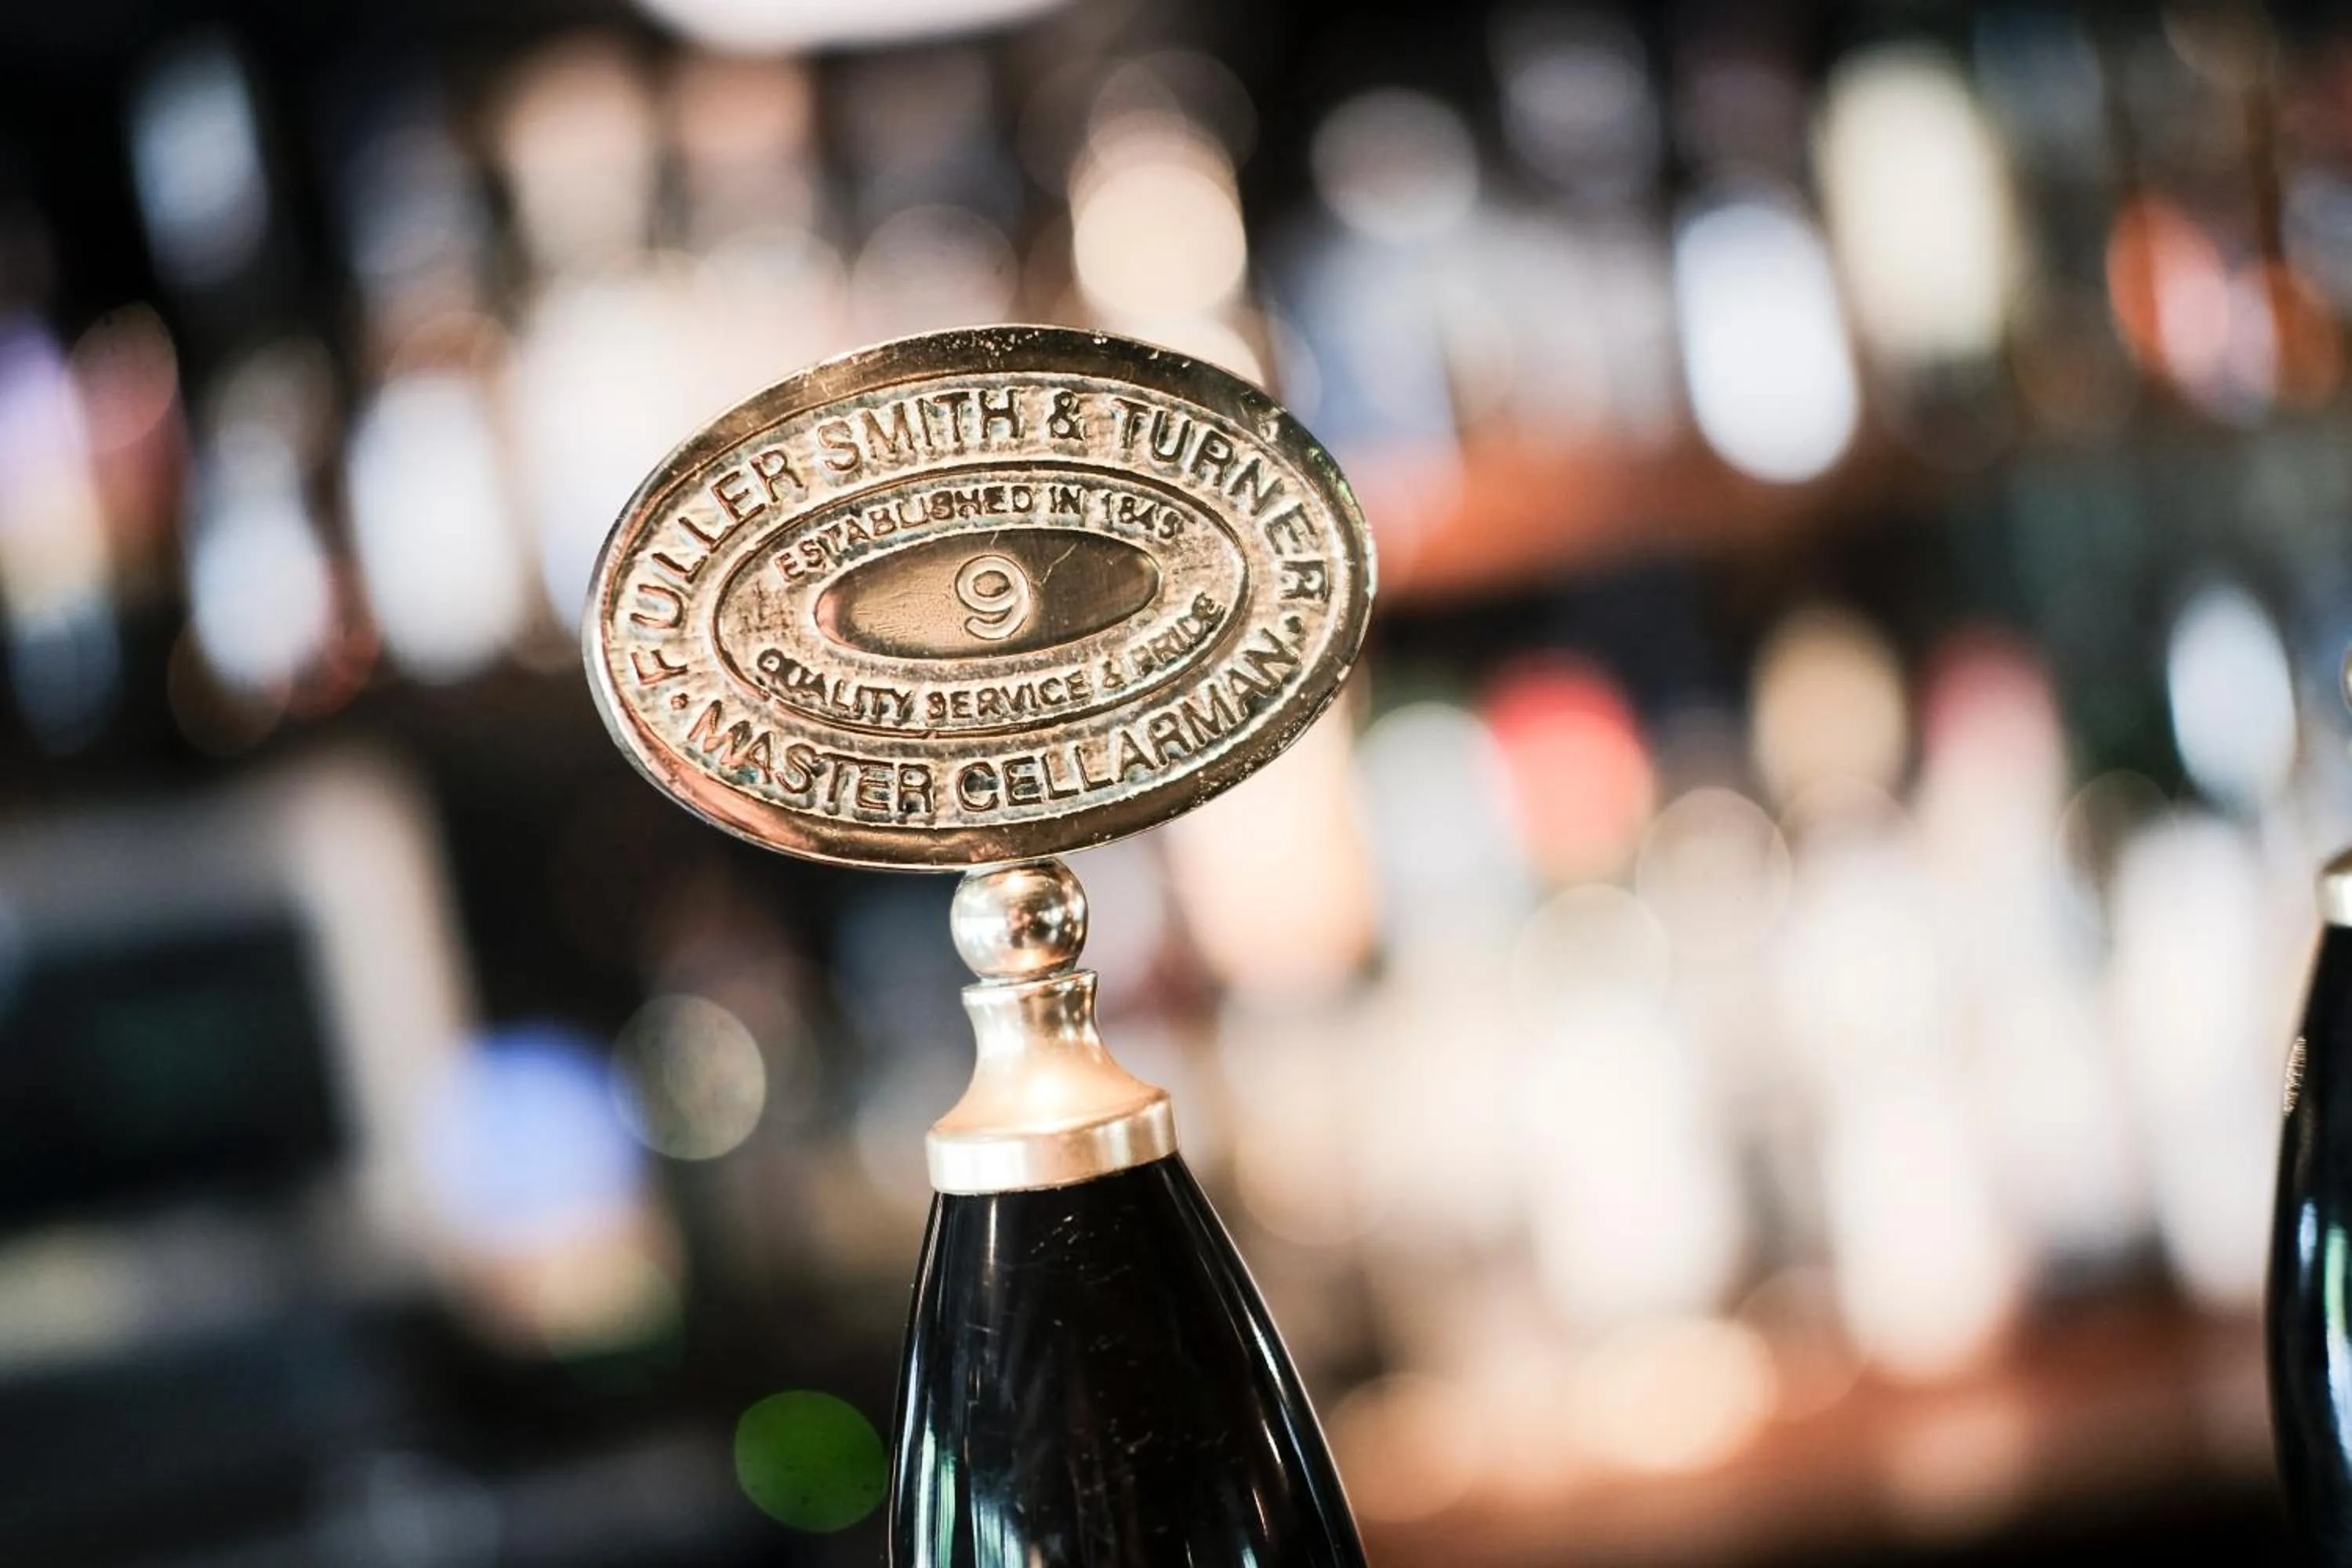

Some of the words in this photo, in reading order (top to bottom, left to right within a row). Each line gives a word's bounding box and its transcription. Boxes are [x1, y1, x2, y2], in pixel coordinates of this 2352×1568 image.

[630, 448, 804, 685] FULLER
[817, 390, 1021, 471] SMITH
[1047, 390, 1086, 441] &
[1113, 397, 1329, 601] TURNER
[774, 485, 1033, 583] ESTABLISHED
[1049, 485, 1083, 514] IN
[954, 554, 1029, 641] 9
[688, 700, 938, 813] MASTER
[956, 628, 1300, 813] CELLARMAN
[757, 648, 916, 725] QUALITY
[927, 670, 1093, 720] SERVICE
[1102, 660, 1124, 689] &
[1129, 591, 1225, 677] PRIDE
